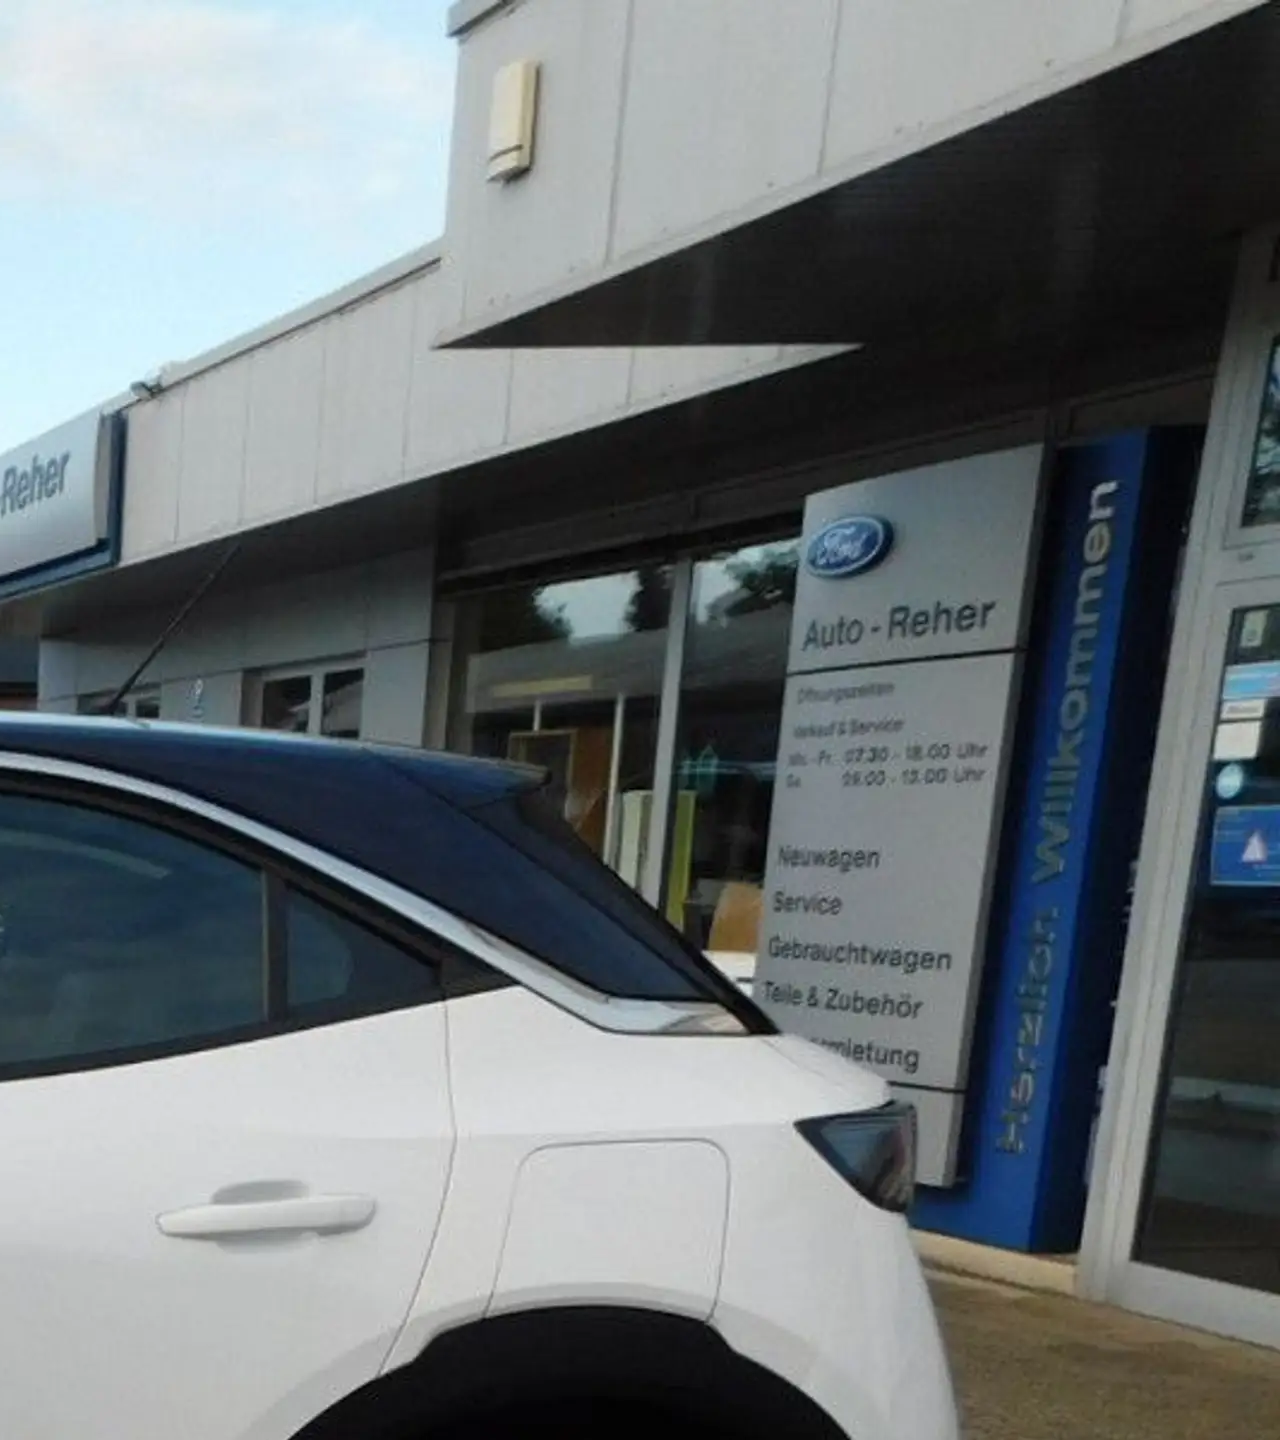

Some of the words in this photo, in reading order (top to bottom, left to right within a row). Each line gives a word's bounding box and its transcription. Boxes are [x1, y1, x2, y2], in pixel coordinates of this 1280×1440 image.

[802, 615, 864, 651] Auto
[887, 601, 996, 641] Reher
[1030, 478, 1120, 885] Willkommen
[777, 845, 880, 872] Neuwagen
[772, 891, 843, 915] Service
[767, 934, 952, 974] Gebrauchtwagen
[762, 981, 804, 1007] Teile
[824, 988, 925, 1020] Zubehör
